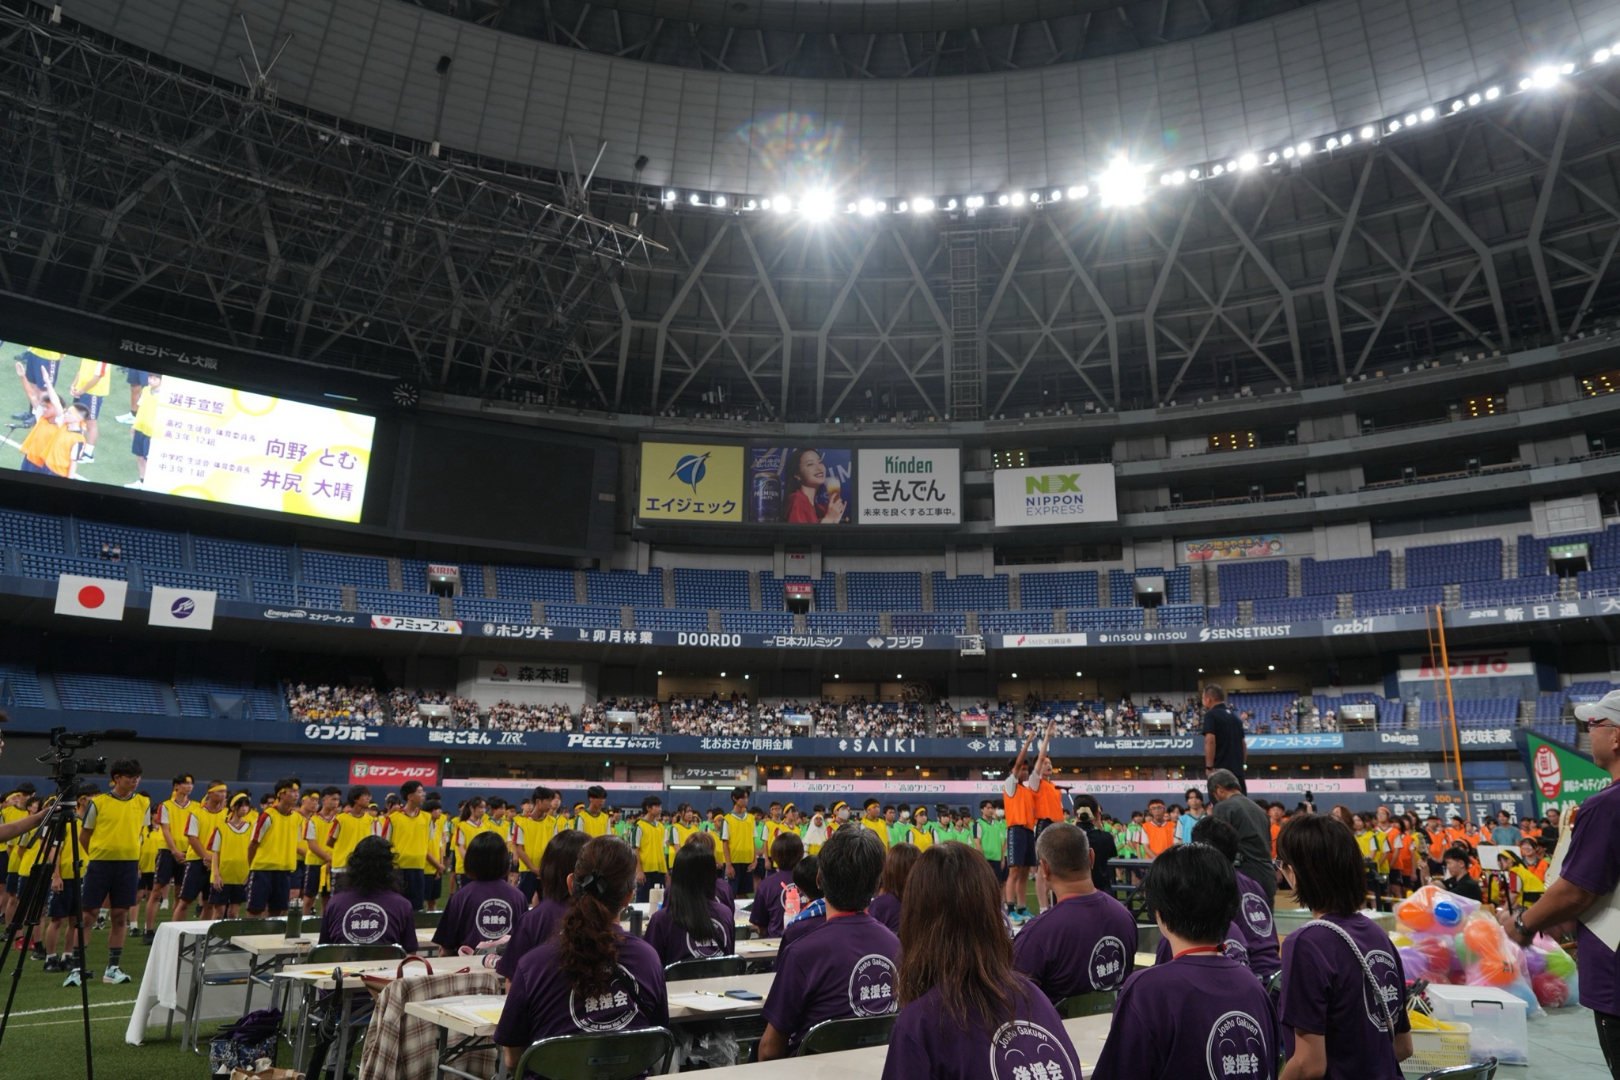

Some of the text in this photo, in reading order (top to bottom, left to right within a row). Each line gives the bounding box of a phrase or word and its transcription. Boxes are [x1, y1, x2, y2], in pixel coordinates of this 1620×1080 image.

[169, 393, 225, 414] 選手宣誓
[266, 438, 358, 470] 向野 とむ
[885, 456, 933, 474] Kinden
[260, 470, 354, 502] 井尻 大晴
[872, 479, 946, 502] きんでん
[645, 498, 736, 514] エイジェック
[1026, 494, 1083, 506] NIPPON
[863, 507, 956, 517] 未来を良くする工事中。
[1026, 504, 1084, 516] EXPRESS
[429, 566, 457, 576] KIRIN
[1504, 602, 1580, 621] 新日通
[394, 617, 446, 632] アミューズ
[496, 623, 554, 640] ホシザキ
[1211, 625, 1291, 639] SENSE TRUST
[1332, 618, 1375, 634] azbil
[593, 629, 653, 644] 卯月林業
[677, 632, 742, 647] DOORDO
[776, 636, 843, 647] 日本カルミック
[886, 636, 924, 648] フジタ
[517, 665, 569, 684] 森本組
[567, 734, 628, 748] PEEES
[701, 738, 793, 750] 北おおさか信用金庫
[1115, 738, 1194, 749] 石田エンジニアリング
[1258, 735, 1342, 748] ファーストステージ
[1381, 732, 1419, 744] Daigas
[1460, 729, 1512, 744] 炭味家
[853, 739, 916, 753] SAIKI
[1371, 768, 1429, 777] ミライト・ワン
[1434, 795, 1451, 803] 100
[860, 982, 892, 1001] 後援会
[584, 990, 628, 1013] 後援会
[1217, 1016, 1259, 1037] Josho Gakuen
[999, 1026, 1048, 1049] Josho Gakuen
[1222, 1052, 1260, 1076] 後援会
